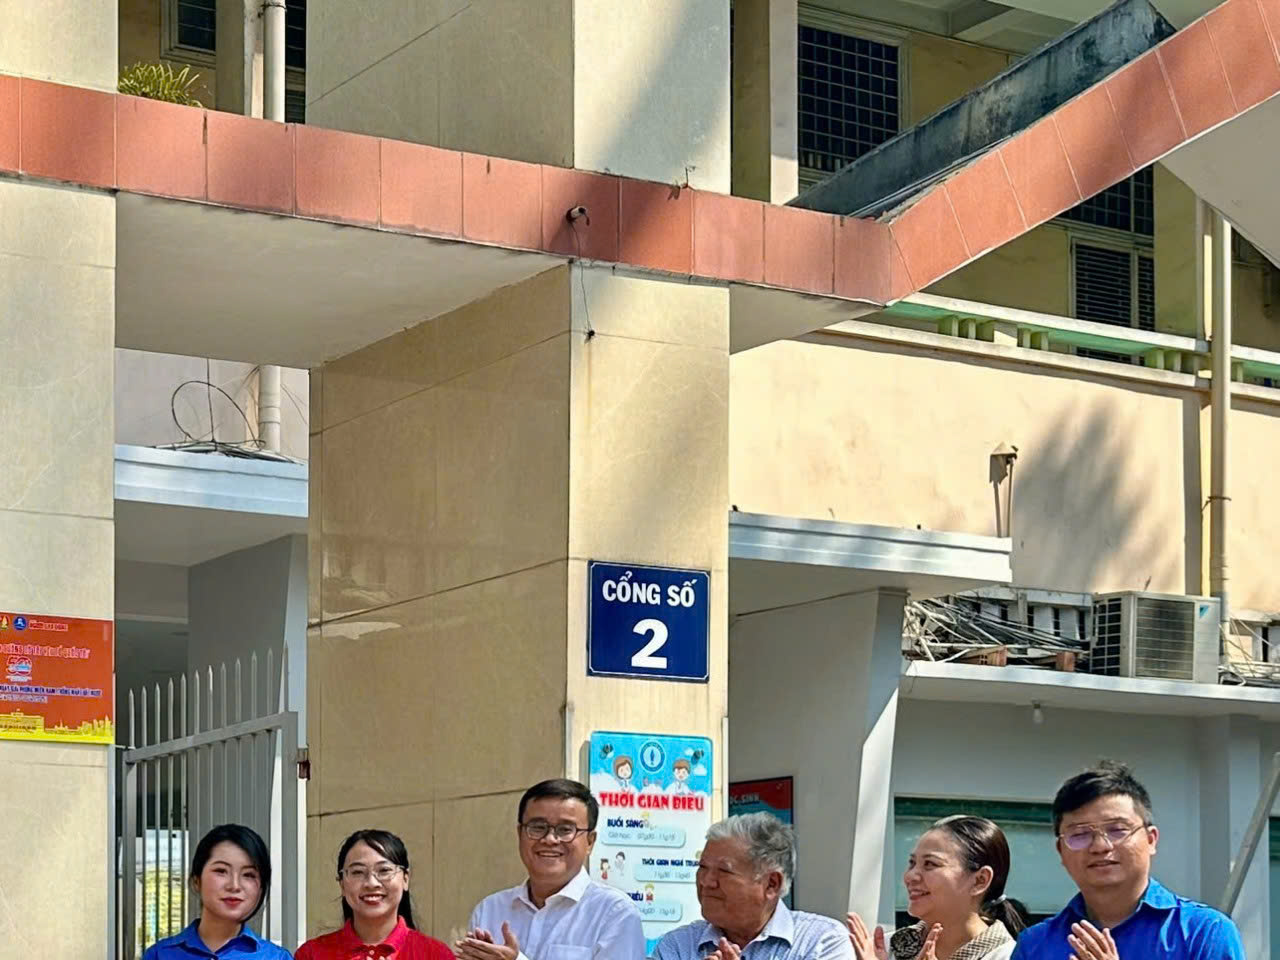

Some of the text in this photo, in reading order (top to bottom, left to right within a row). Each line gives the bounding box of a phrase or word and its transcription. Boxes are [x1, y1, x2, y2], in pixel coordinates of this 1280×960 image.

[602, 571, 697, 608] CỔNG SỐ
[631, 618, 668, 669] 2
[599, 789, 634, 807] THỜI
[637, 793, 669, 810] GIAN
[625, 817, 644, 828] SÁNG
